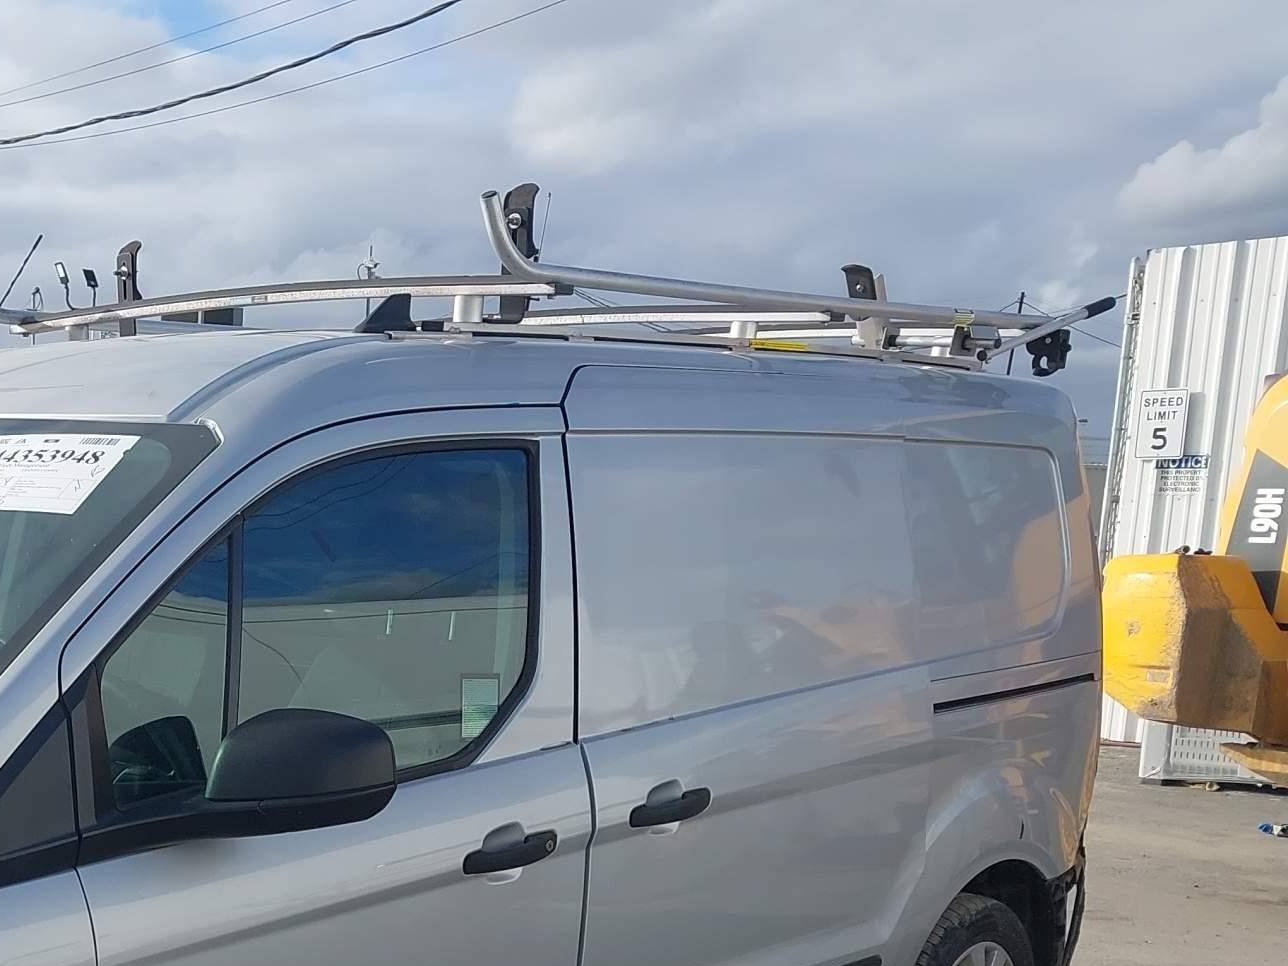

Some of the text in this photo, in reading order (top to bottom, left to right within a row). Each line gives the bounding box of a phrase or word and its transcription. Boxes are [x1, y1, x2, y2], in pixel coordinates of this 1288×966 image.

[1143, 397, 1184, 407] SPEED
[1146, 410, 1178, 421] LIMIT
[1151, 427, 1168, 450] 5
[1158, 456, 1207, 468] NOTICE
[1248, 488, 1286, 544] L90H
